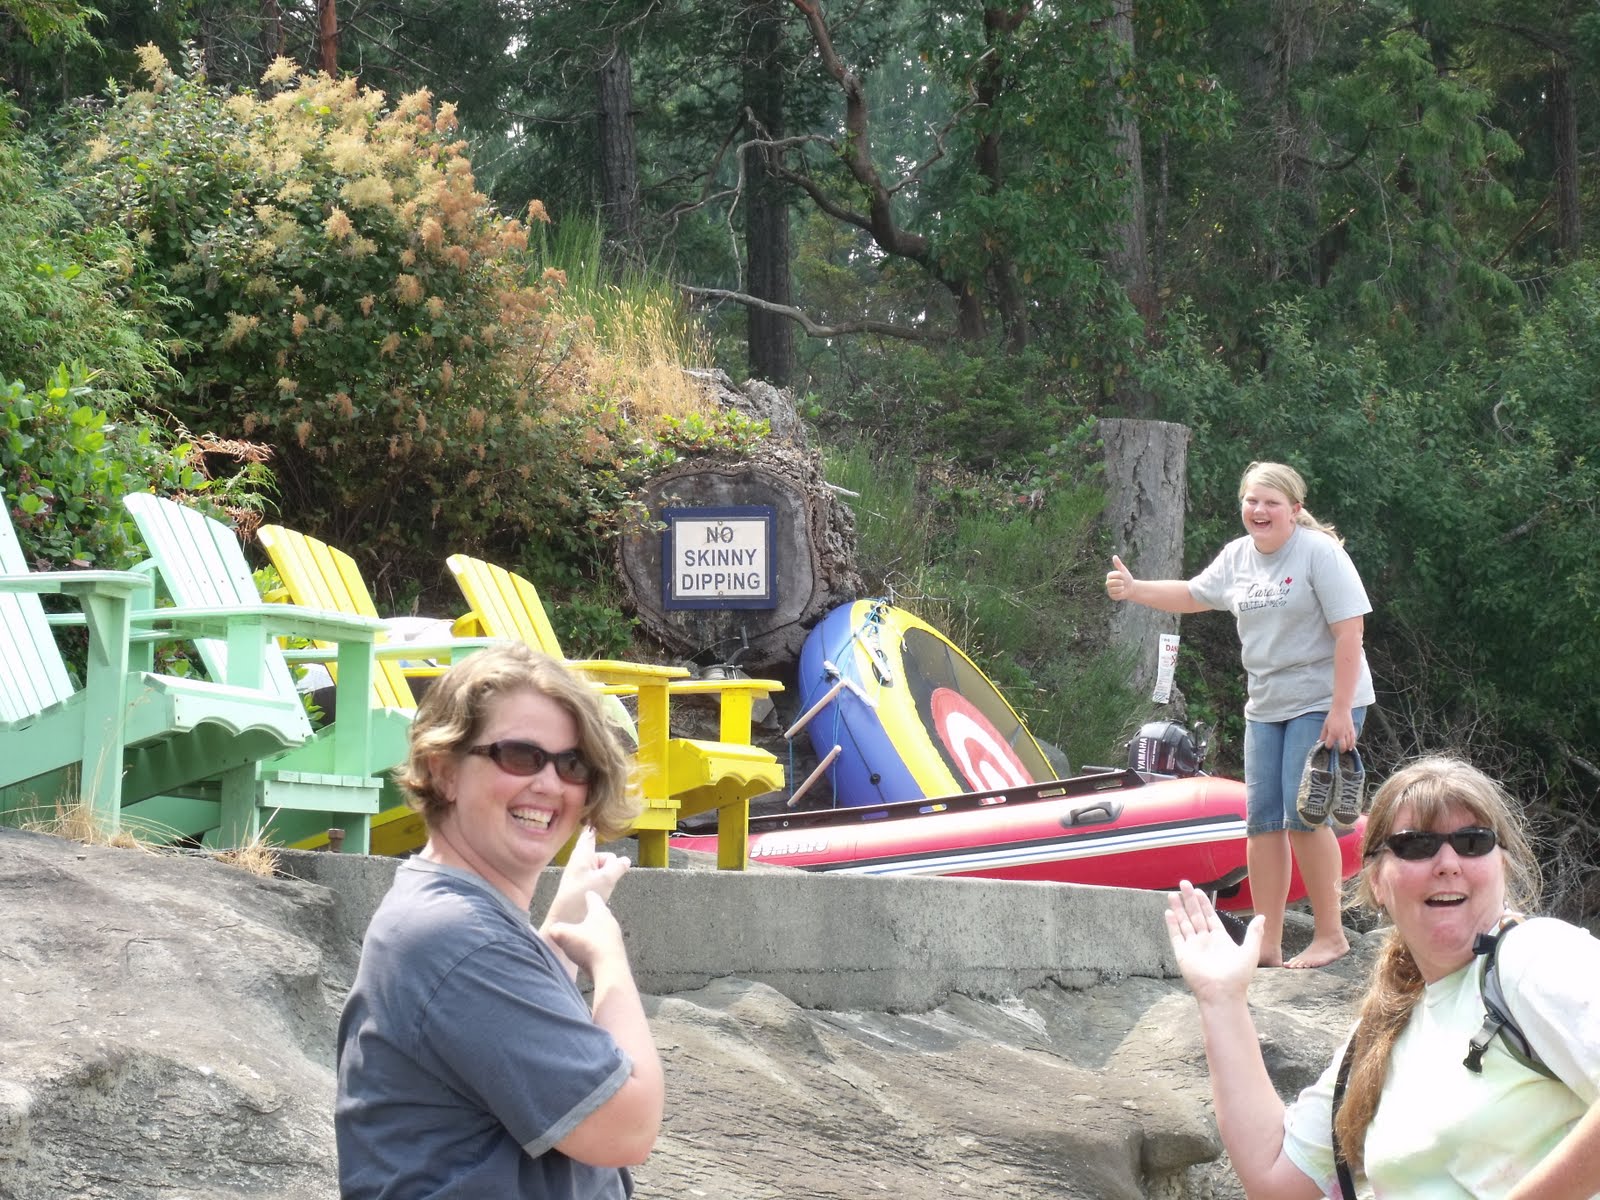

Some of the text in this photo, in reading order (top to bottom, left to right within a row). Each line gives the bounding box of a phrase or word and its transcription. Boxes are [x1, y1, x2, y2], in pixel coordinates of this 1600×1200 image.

[706, 526, 734, 544] NO
[684, 548, 757, 567] SKINNY
[682, 572, 760, 590] DIPPING
[1137, 737, 1148, 770] YAMAHA
